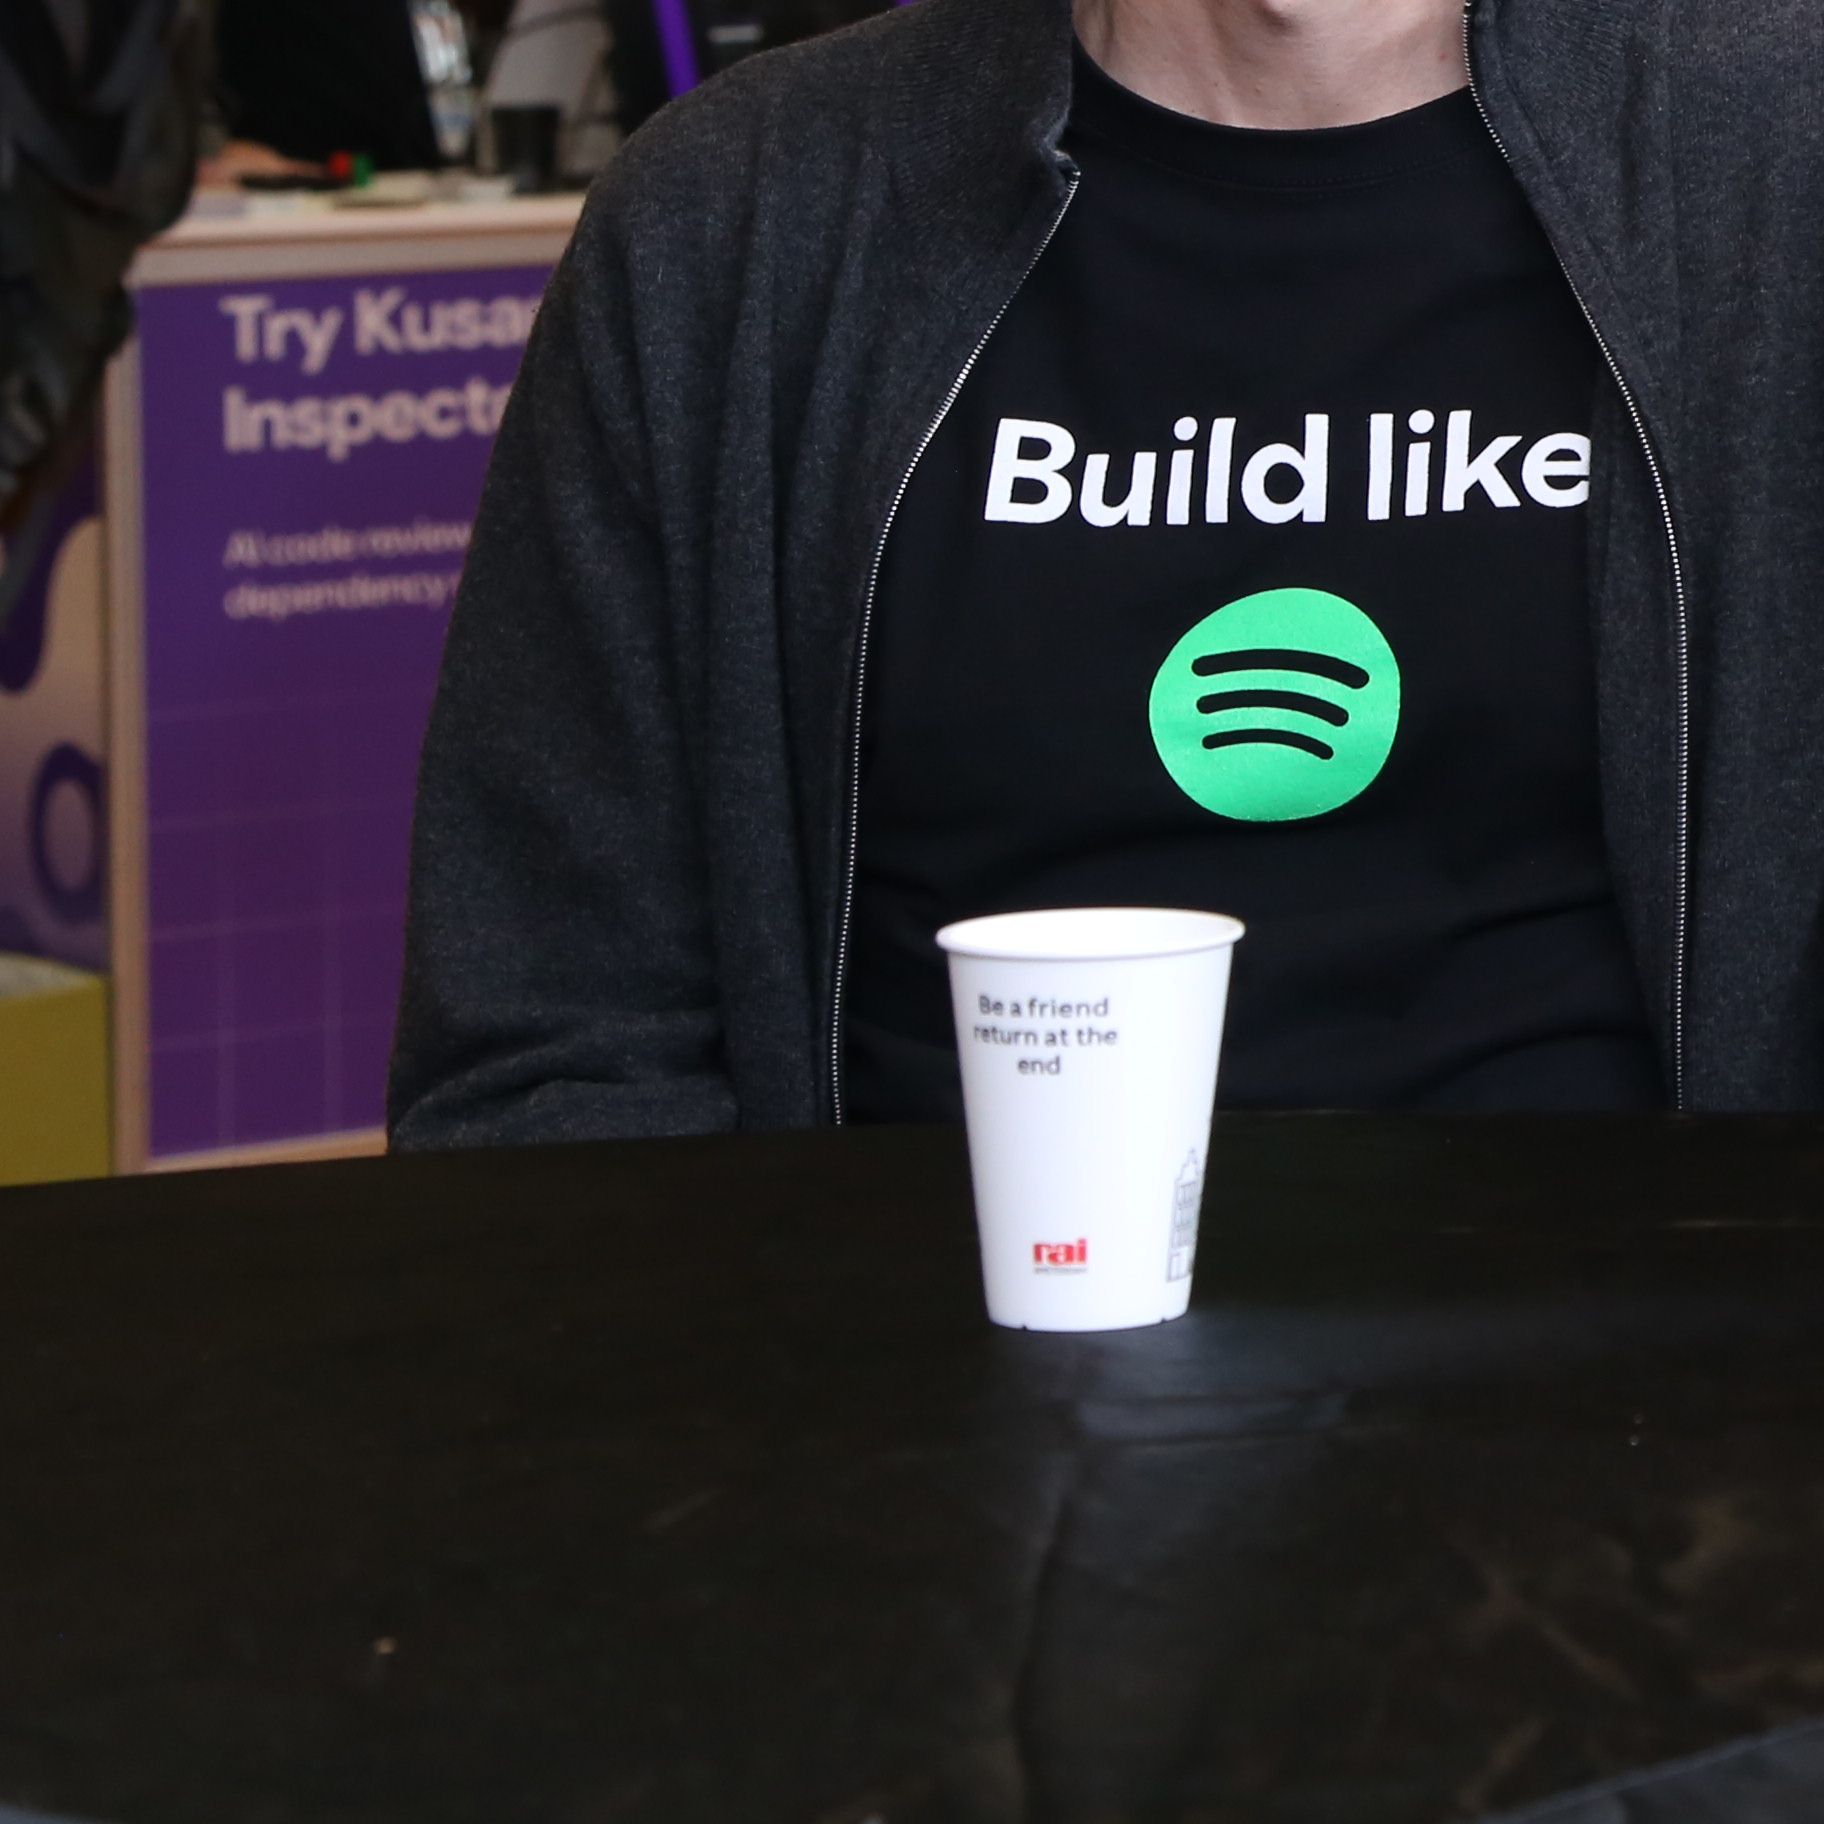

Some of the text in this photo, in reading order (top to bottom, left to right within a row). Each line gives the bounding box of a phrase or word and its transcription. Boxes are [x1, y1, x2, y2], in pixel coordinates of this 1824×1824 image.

[218, 294, 343, 375] Try
[983, 409, 1592, 527] Build like
[979, 994, 1110, 1018] Be a friend
[973, 1025, 1118, 1047] return at the
[1017, 1056, 1061, 1075] end
[1034, 1238, 1086, 1266] rai
